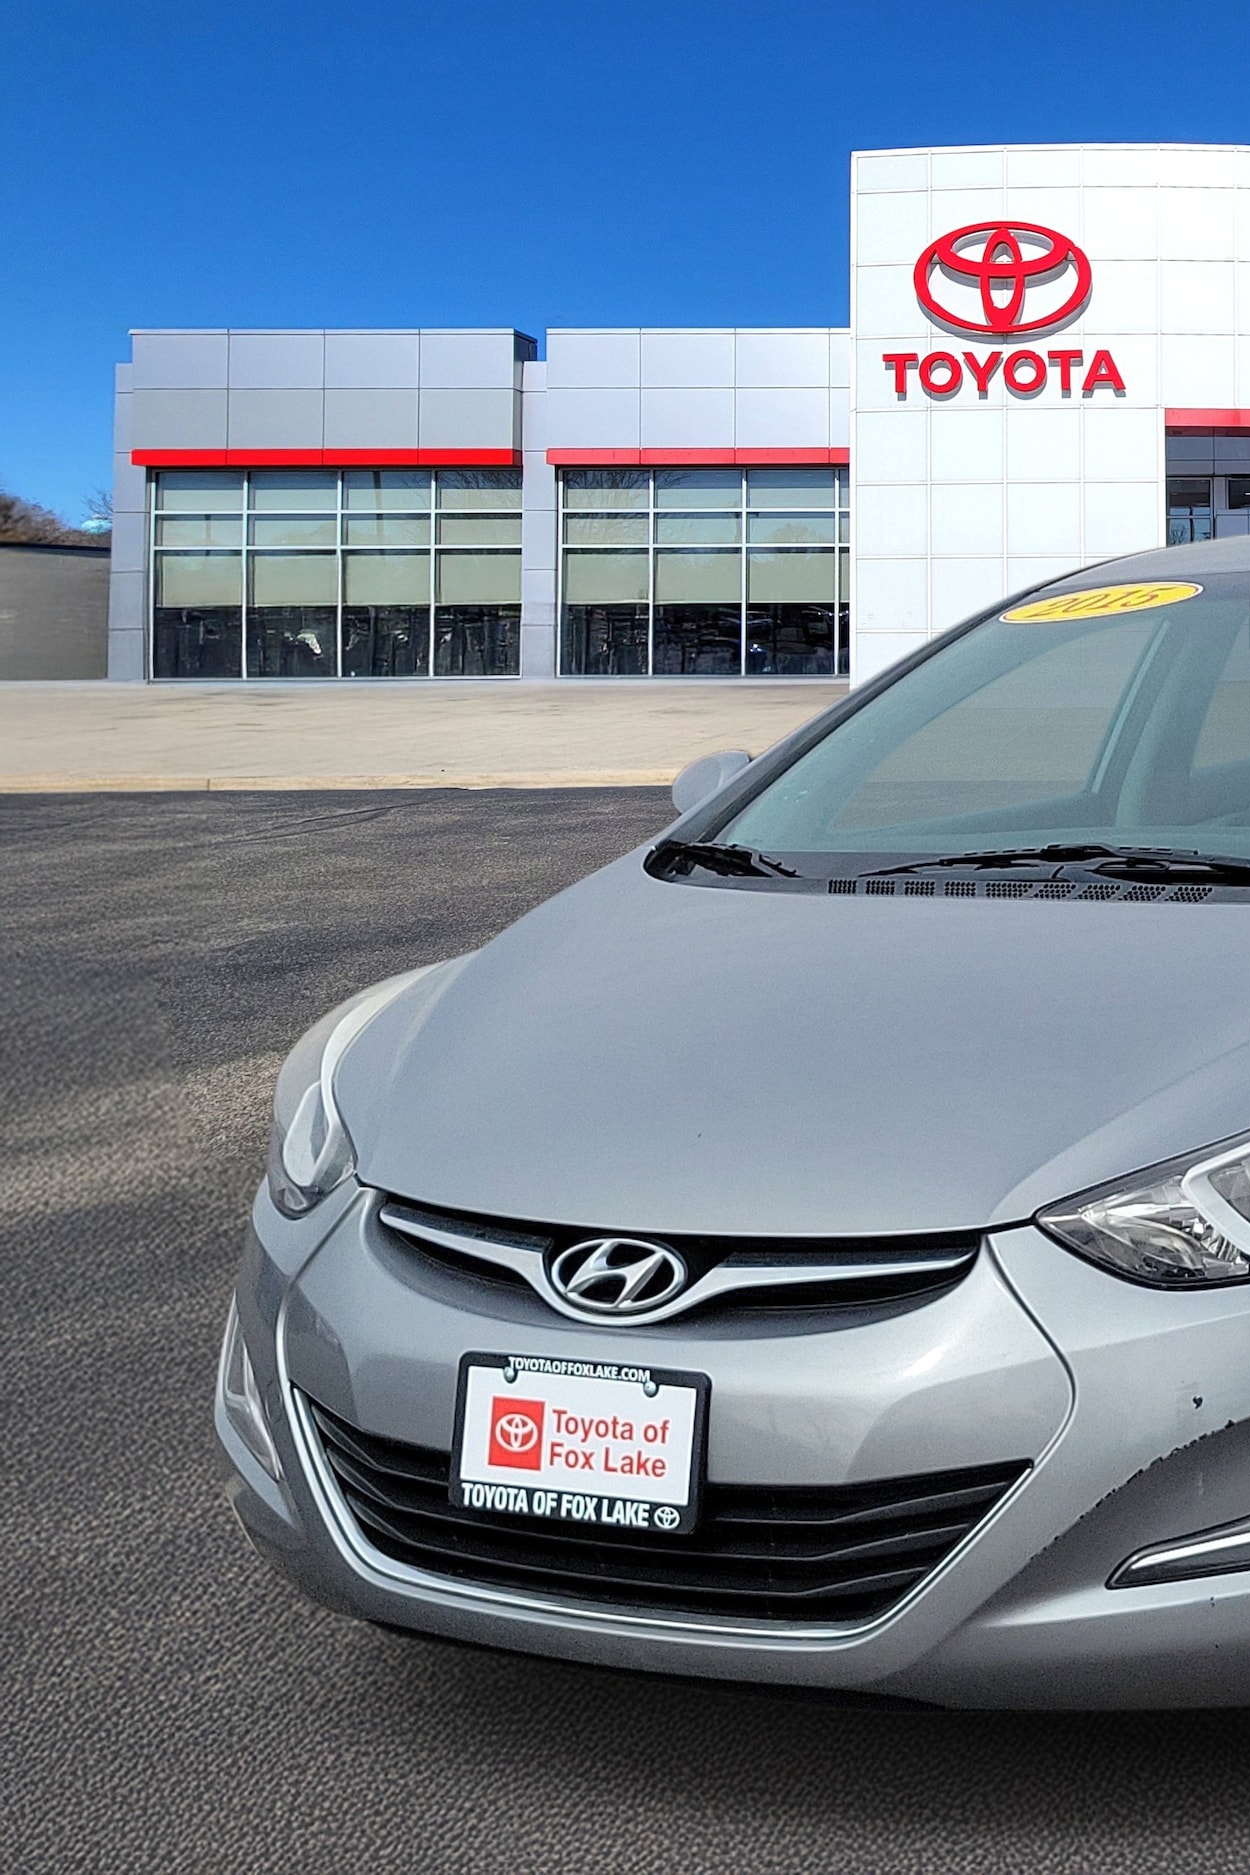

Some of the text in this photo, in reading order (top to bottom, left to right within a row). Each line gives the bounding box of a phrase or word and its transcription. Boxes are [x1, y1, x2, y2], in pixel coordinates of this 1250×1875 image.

[882, 350, 1126, 397] TOYOTA
[1024, 586, 1178, 618] 2015
[508, 1356, 651, 1382] TOYOTAOFFOXLAKE.COM
[552, 1409, 670, 1443] Toyota of
[549, 1442, 667, 1477] Fox Lake
[461, 1483, 650, 1526] TOYOTA OF FOX LAKE
